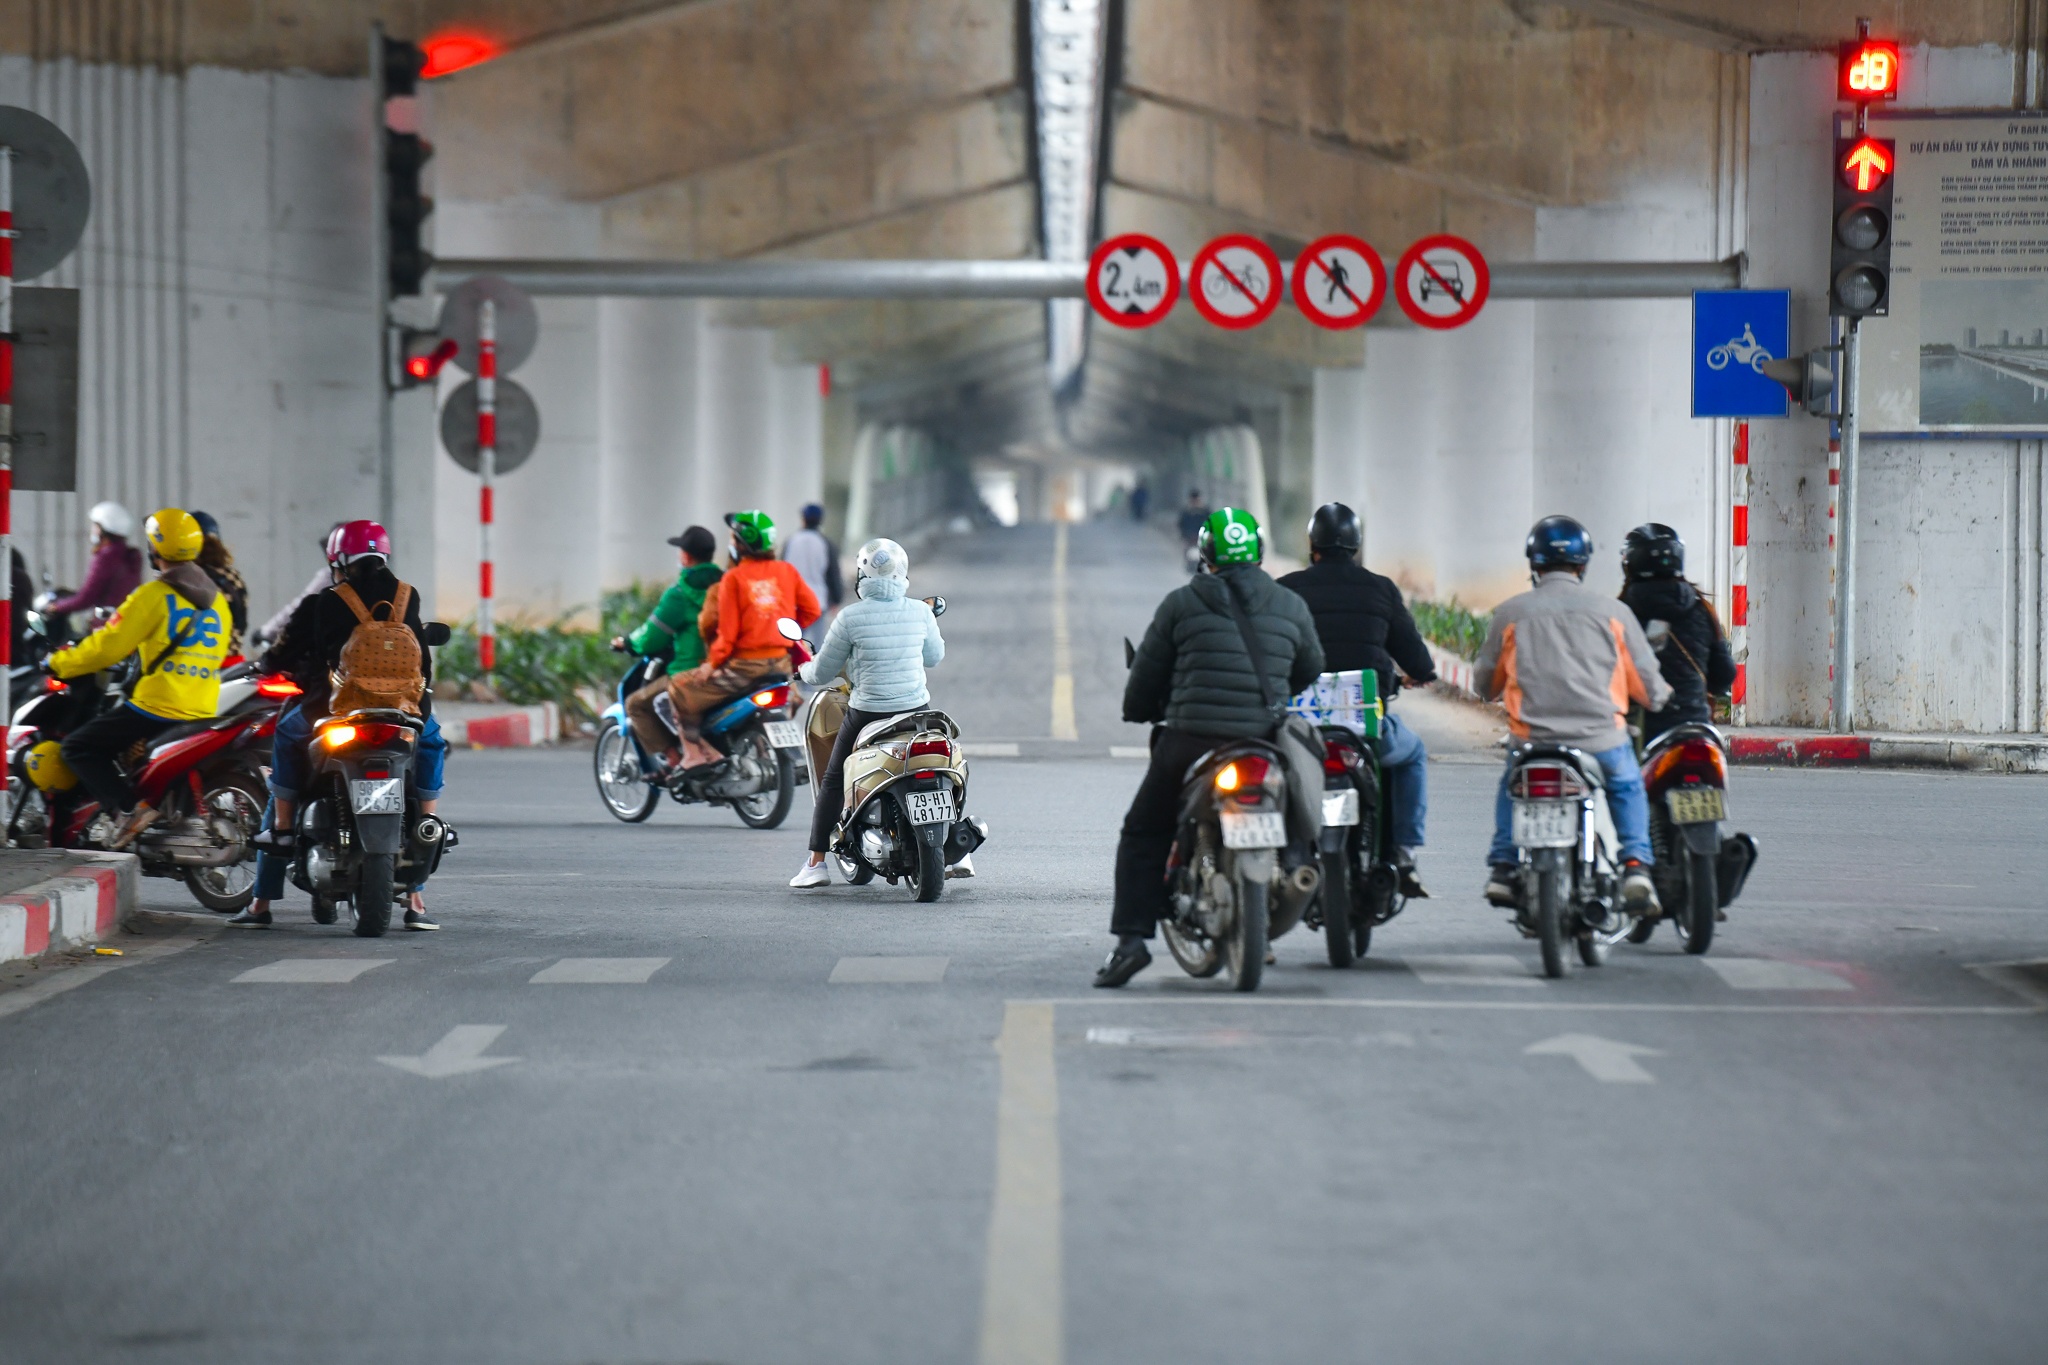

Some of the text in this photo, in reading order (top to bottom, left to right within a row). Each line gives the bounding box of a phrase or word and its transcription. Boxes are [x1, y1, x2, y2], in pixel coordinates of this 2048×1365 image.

[1910, 141, 1924, 154] DỰ
[1926, 140, 1940, 153] ÁN
[166, 593, 222, 648] be
[913, 792, 947, 808] 29-H1
[913, 806, 952, 823] 481.77
